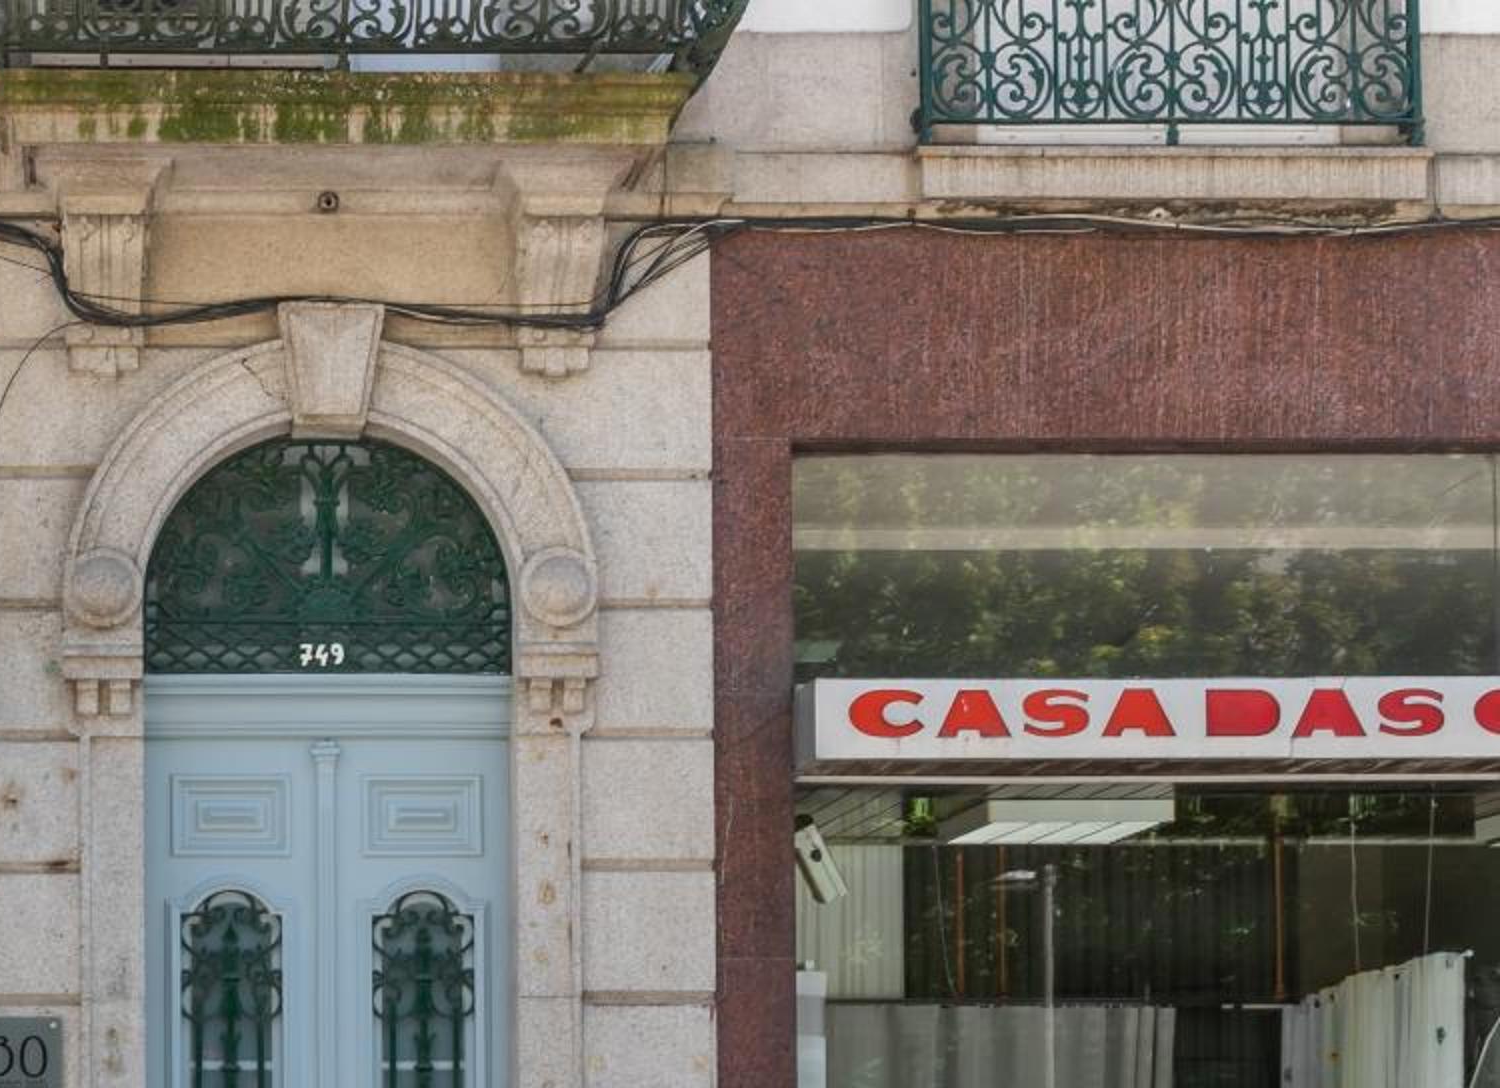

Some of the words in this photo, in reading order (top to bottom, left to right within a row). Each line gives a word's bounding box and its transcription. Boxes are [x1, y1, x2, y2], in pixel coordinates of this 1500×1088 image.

[299, 642, 345, 668] 749
[848, 687, 1178, 738] CASA
[1204, 687, 1446, 738] DAS
